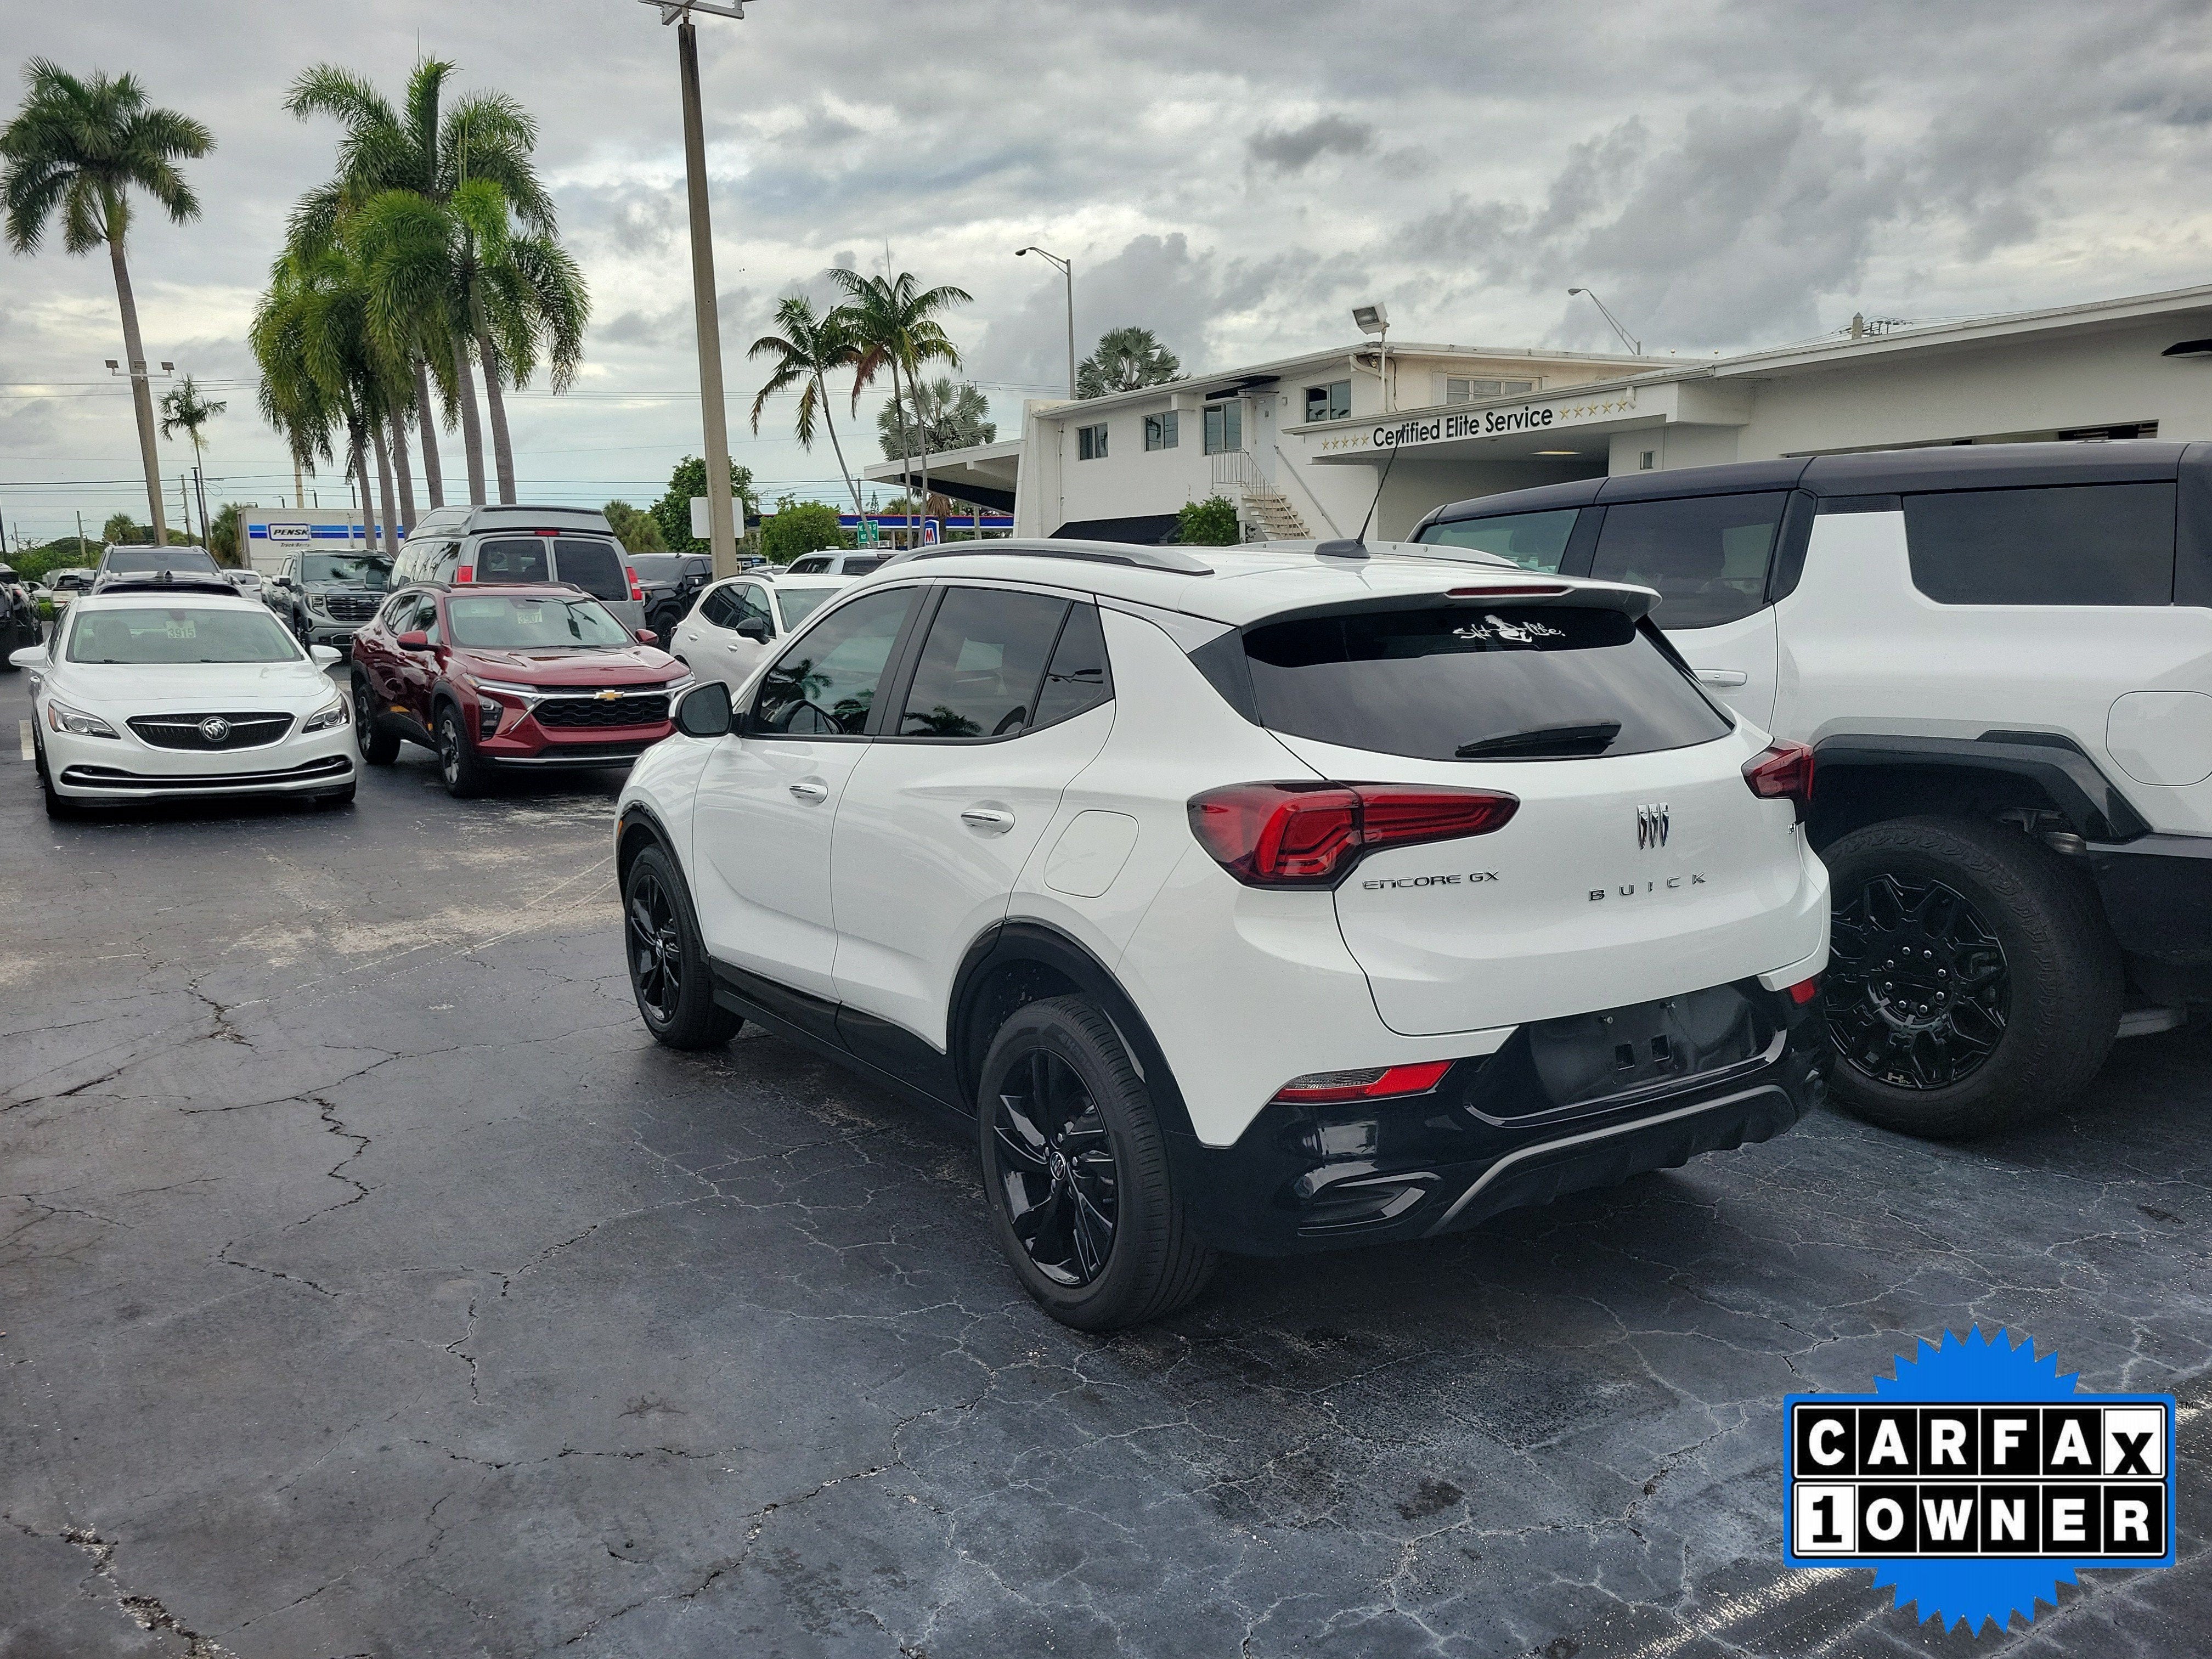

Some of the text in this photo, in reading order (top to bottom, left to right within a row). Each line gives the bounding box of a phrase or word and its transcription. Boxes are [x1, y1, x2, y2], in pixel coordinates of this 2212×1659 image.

[1446, 415, 1480, 438] Elite
[1485, 406, 1554, 433] Service
[926, 529, 934, 542] M
[1362, 871, 1499, 890] ENCORE GX
[1588, 872, 1706, 901] BUICK
